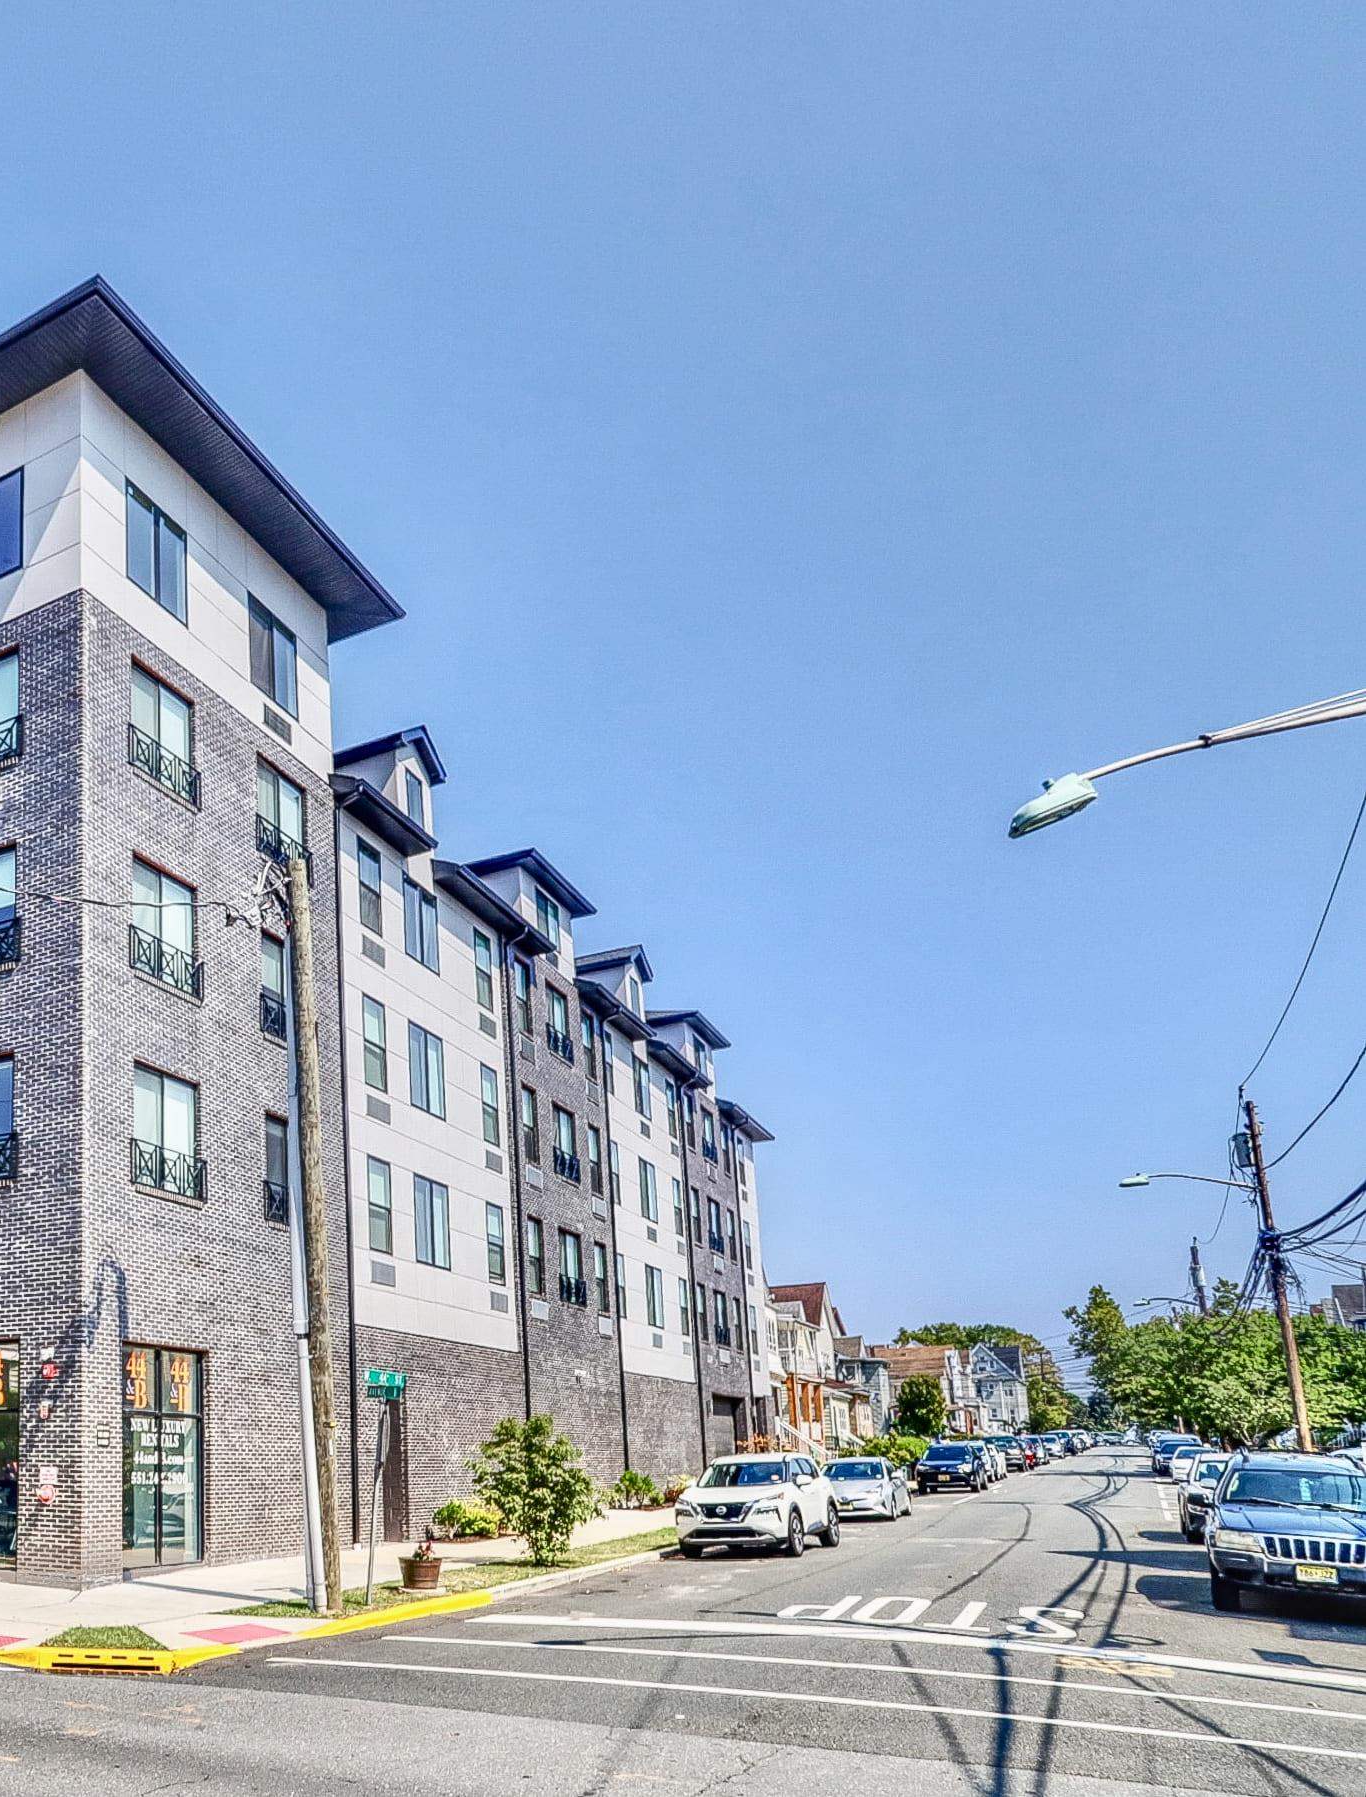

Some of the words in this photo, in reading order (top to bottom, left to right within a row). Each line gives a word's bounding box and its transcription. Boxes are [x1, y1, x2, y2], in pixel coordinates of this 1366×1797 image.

[125, 1351, 147, 1380] 44
[170, 1356, 190, 1384] 44
[130, 1418, 150, 1431] NEW
[777, 1596, 1085, 1639] STOP
